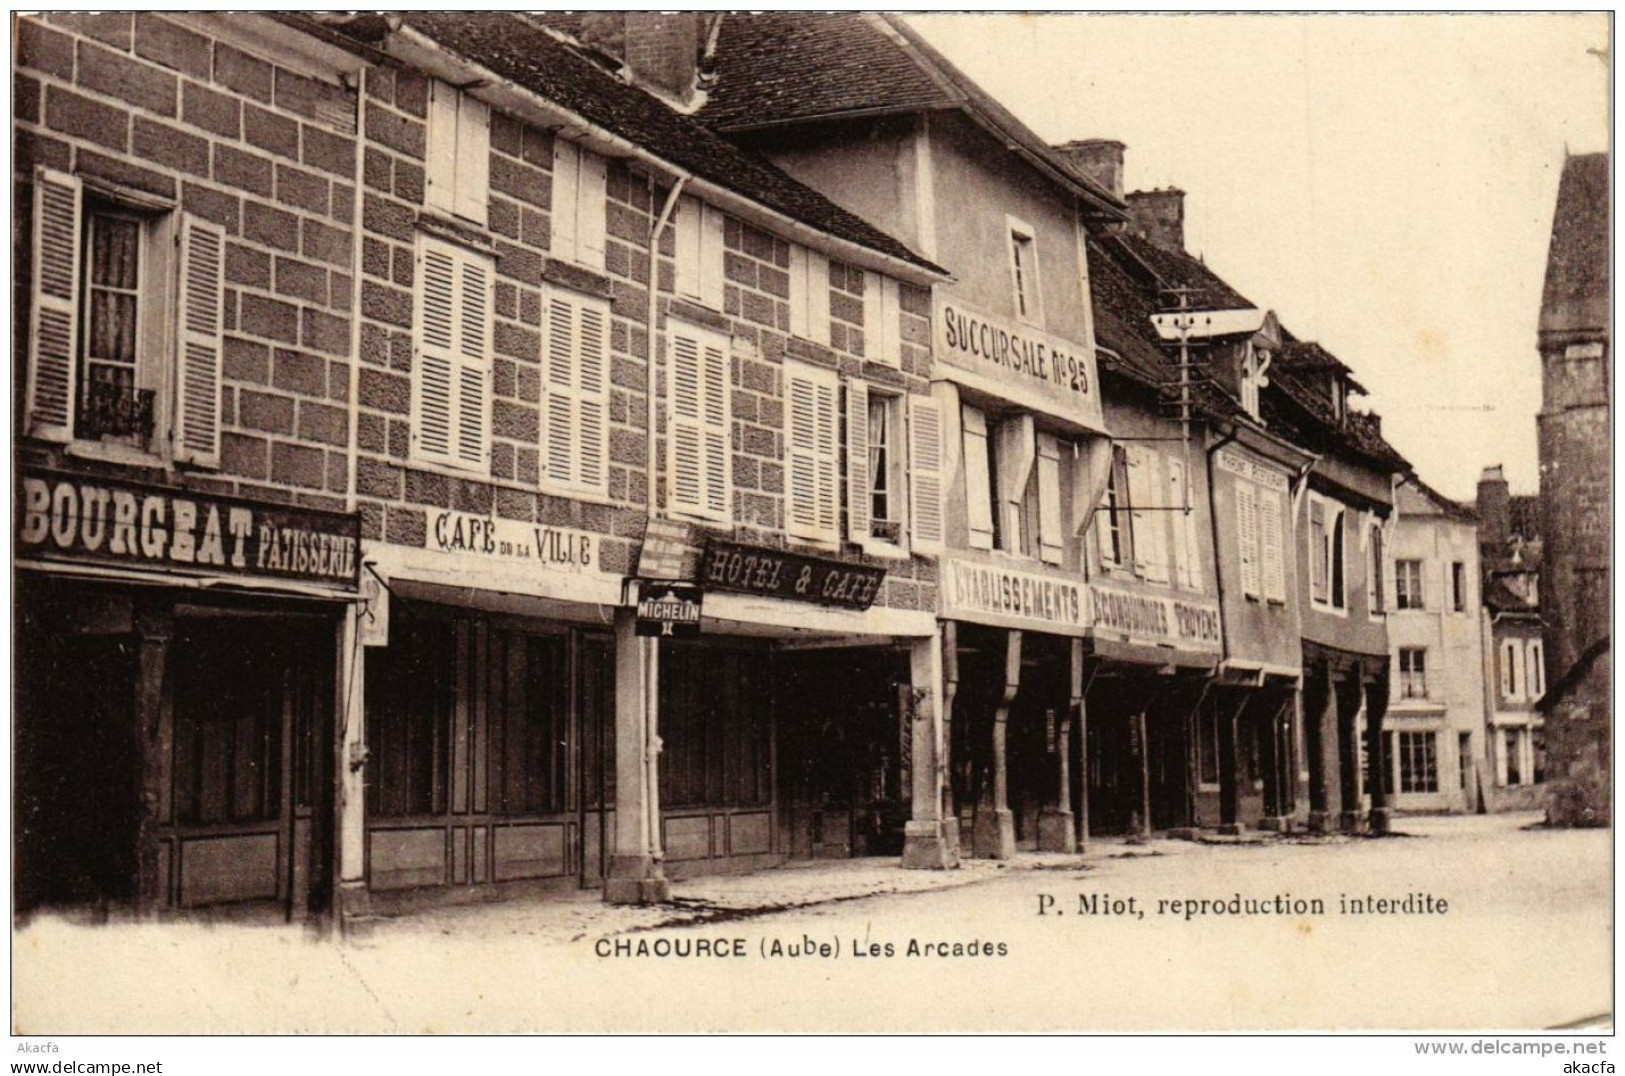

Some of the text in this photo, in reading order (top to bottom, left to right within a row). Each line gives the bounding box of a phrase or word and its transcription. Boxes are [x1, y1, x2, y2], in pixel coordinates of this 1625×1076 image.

[945, 306, 1047, 380] SUCCURSALE
[1068, 356, 1088, 394] 25
[20, 477, 252, 567] BOURGEAT
[796, 564, 811, 594] &
[637, 602, 700, 621] MICHELIN
